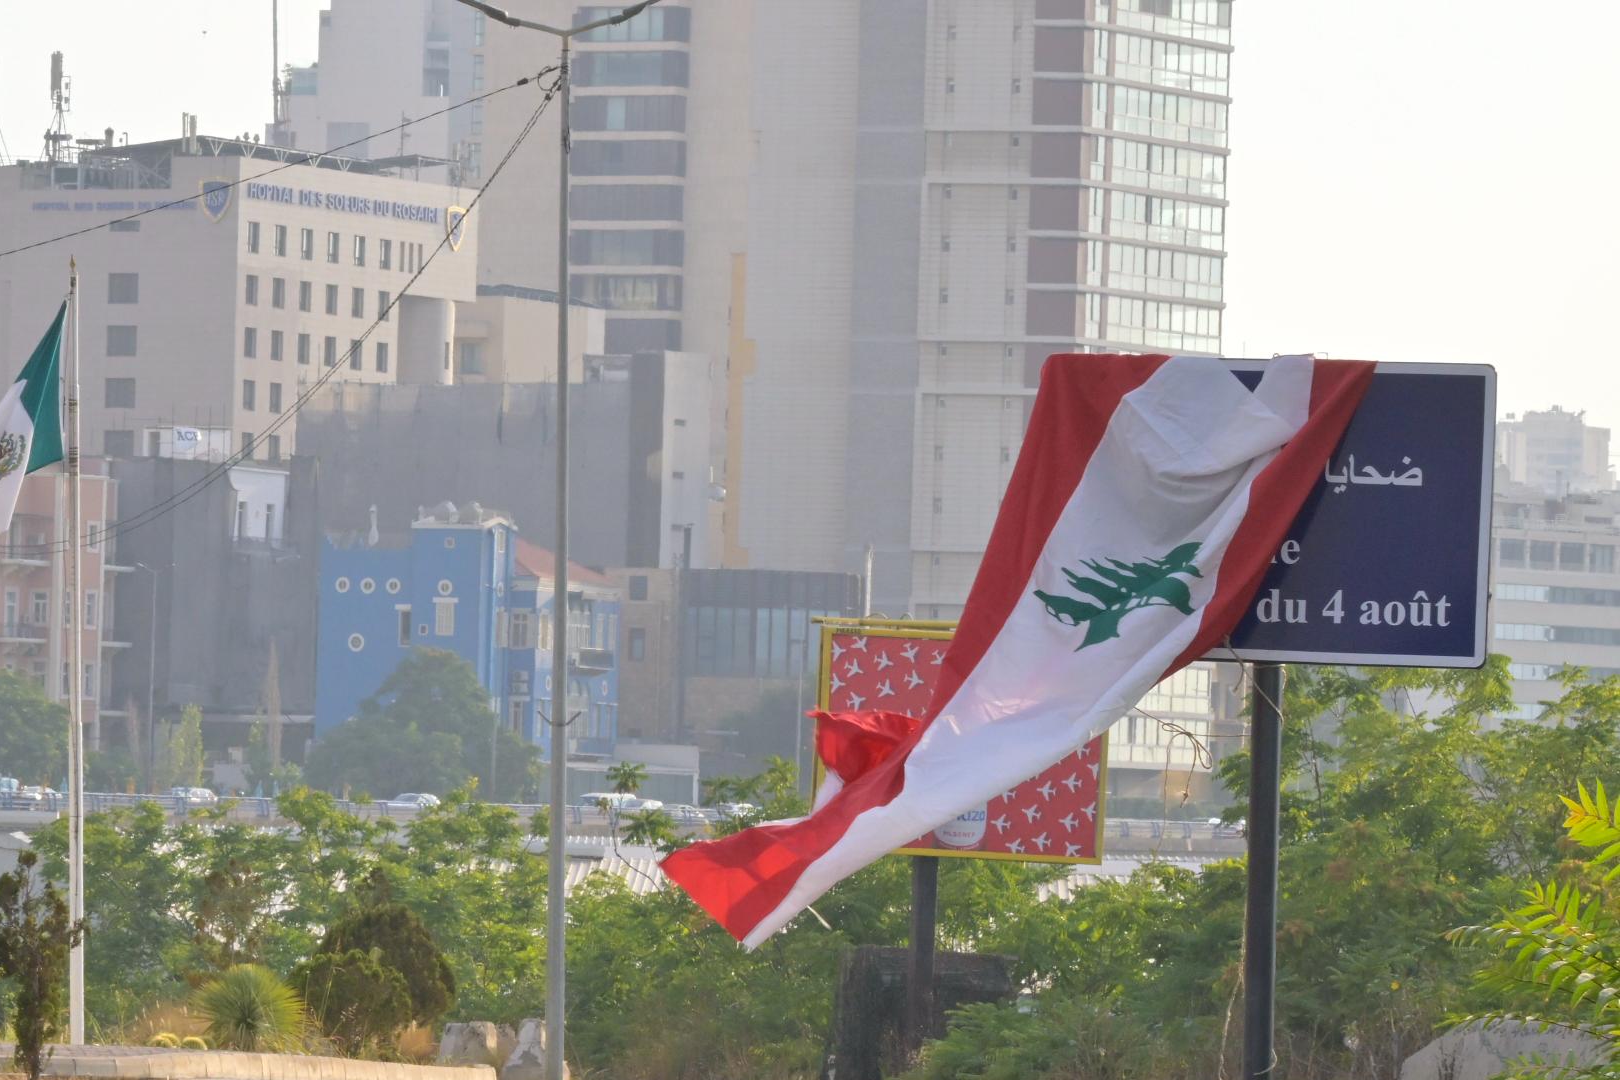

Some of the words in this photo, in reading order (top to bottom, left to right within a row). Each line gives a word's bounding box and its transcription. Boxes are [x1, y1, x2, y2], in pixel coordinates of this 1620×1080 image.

[374, 200, 390, 217] DU
[1324, 454, 1423, 494] ضحايا
[1256, 589, 1308, 624] du
[1322, 589, 1345, 624] 4
[1359, 590, 1452, 627] août
